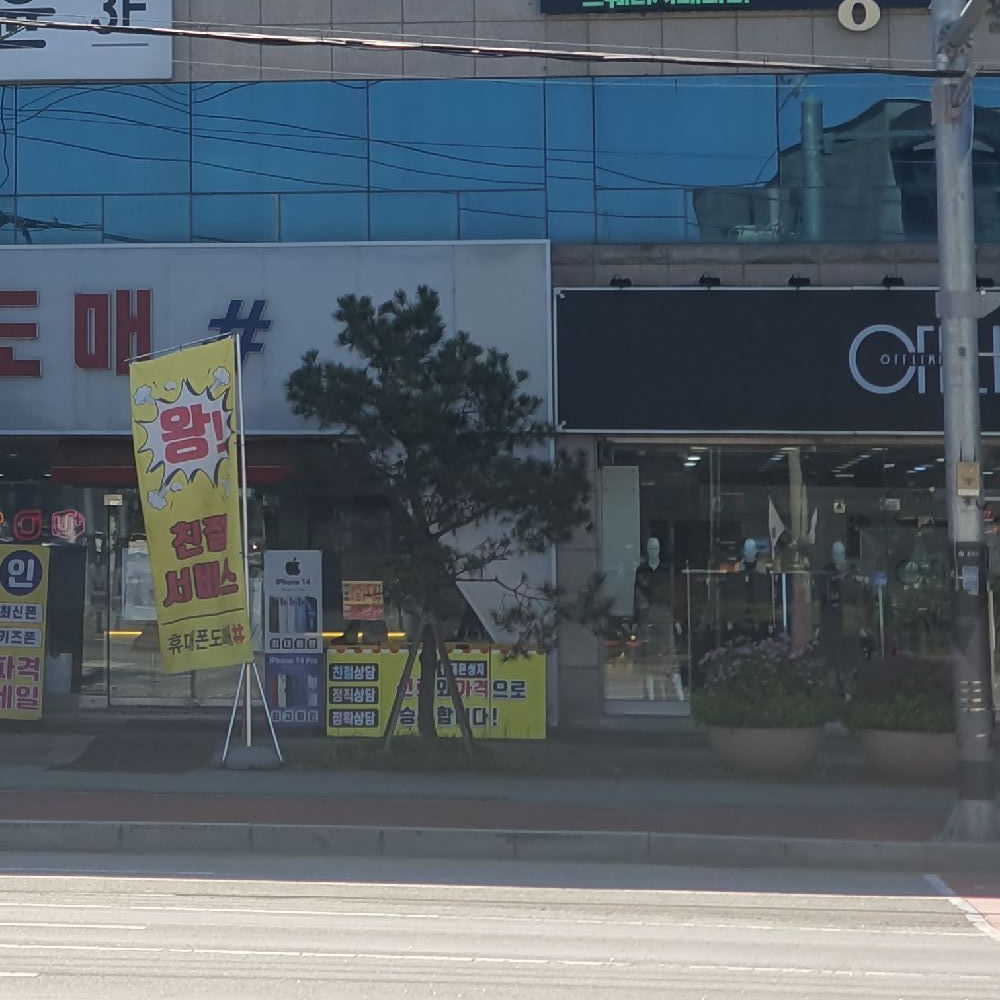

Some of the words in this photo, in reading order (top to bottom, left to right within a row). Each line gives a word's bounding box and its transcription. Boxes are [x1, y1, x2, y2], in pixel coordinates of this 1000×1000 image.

[159, 403, 227, 464] 왕!
[7, 558, 34, 588] 인
[0, 604, 37, 619] 최신폰
[332, 664, 376, 680] 친절상담
